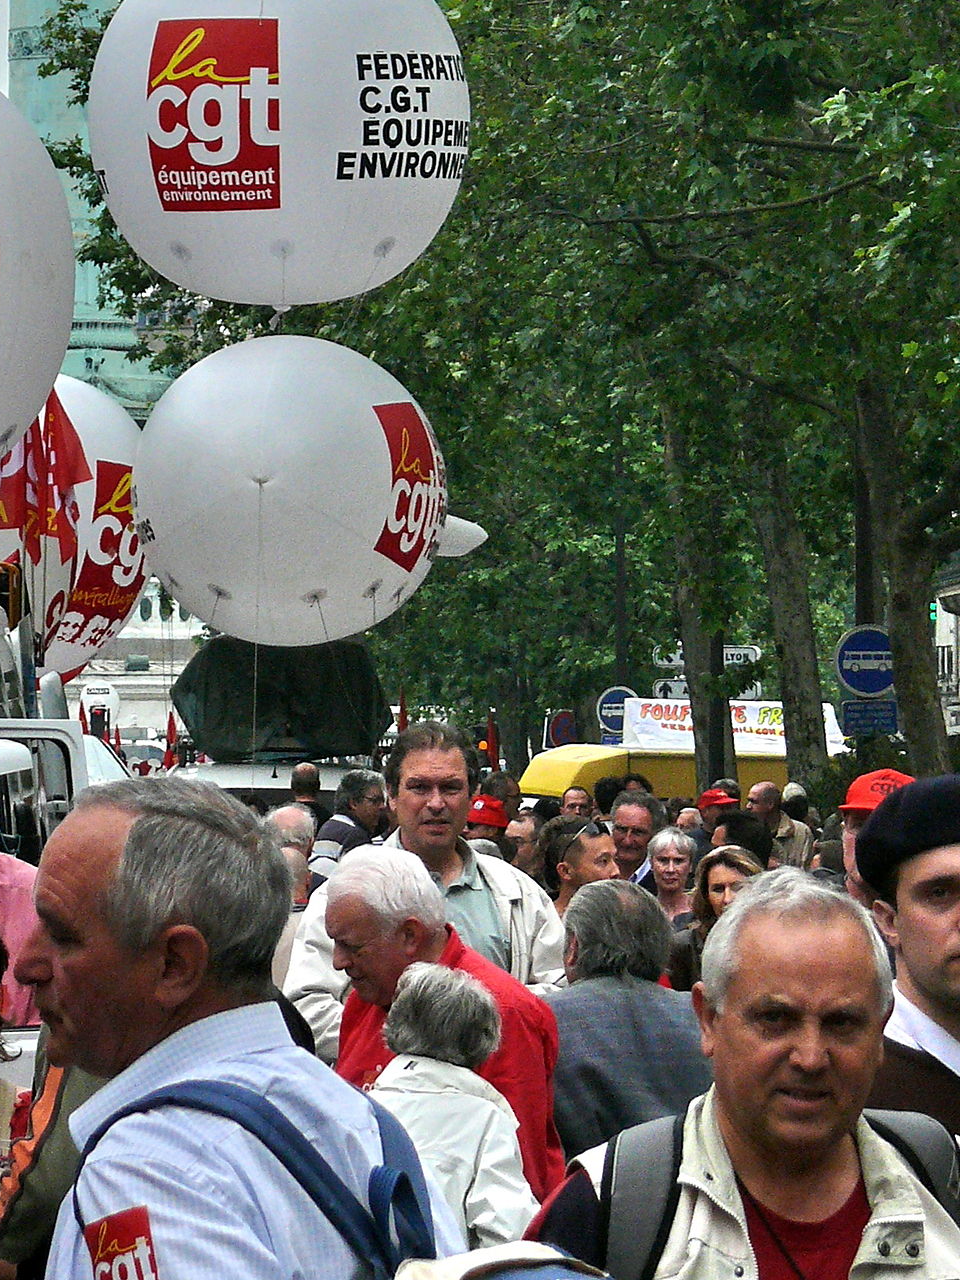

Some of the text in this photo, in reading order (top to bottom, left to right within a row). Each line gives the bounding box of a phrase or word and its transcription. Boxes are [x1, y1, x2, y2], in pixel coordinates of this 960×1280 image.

[151, 27, 279, 88] la
[146, 67, 280, 167] cgt
[359, 85, 431, 114] C.G.T
[157, 164, 276, 190] équipement
[162, 187, 273, 202] environnement
[395, 428, 432, 482] la
[88, 514, 145, 586] cg
[94, 1221, 148, 1265] la
